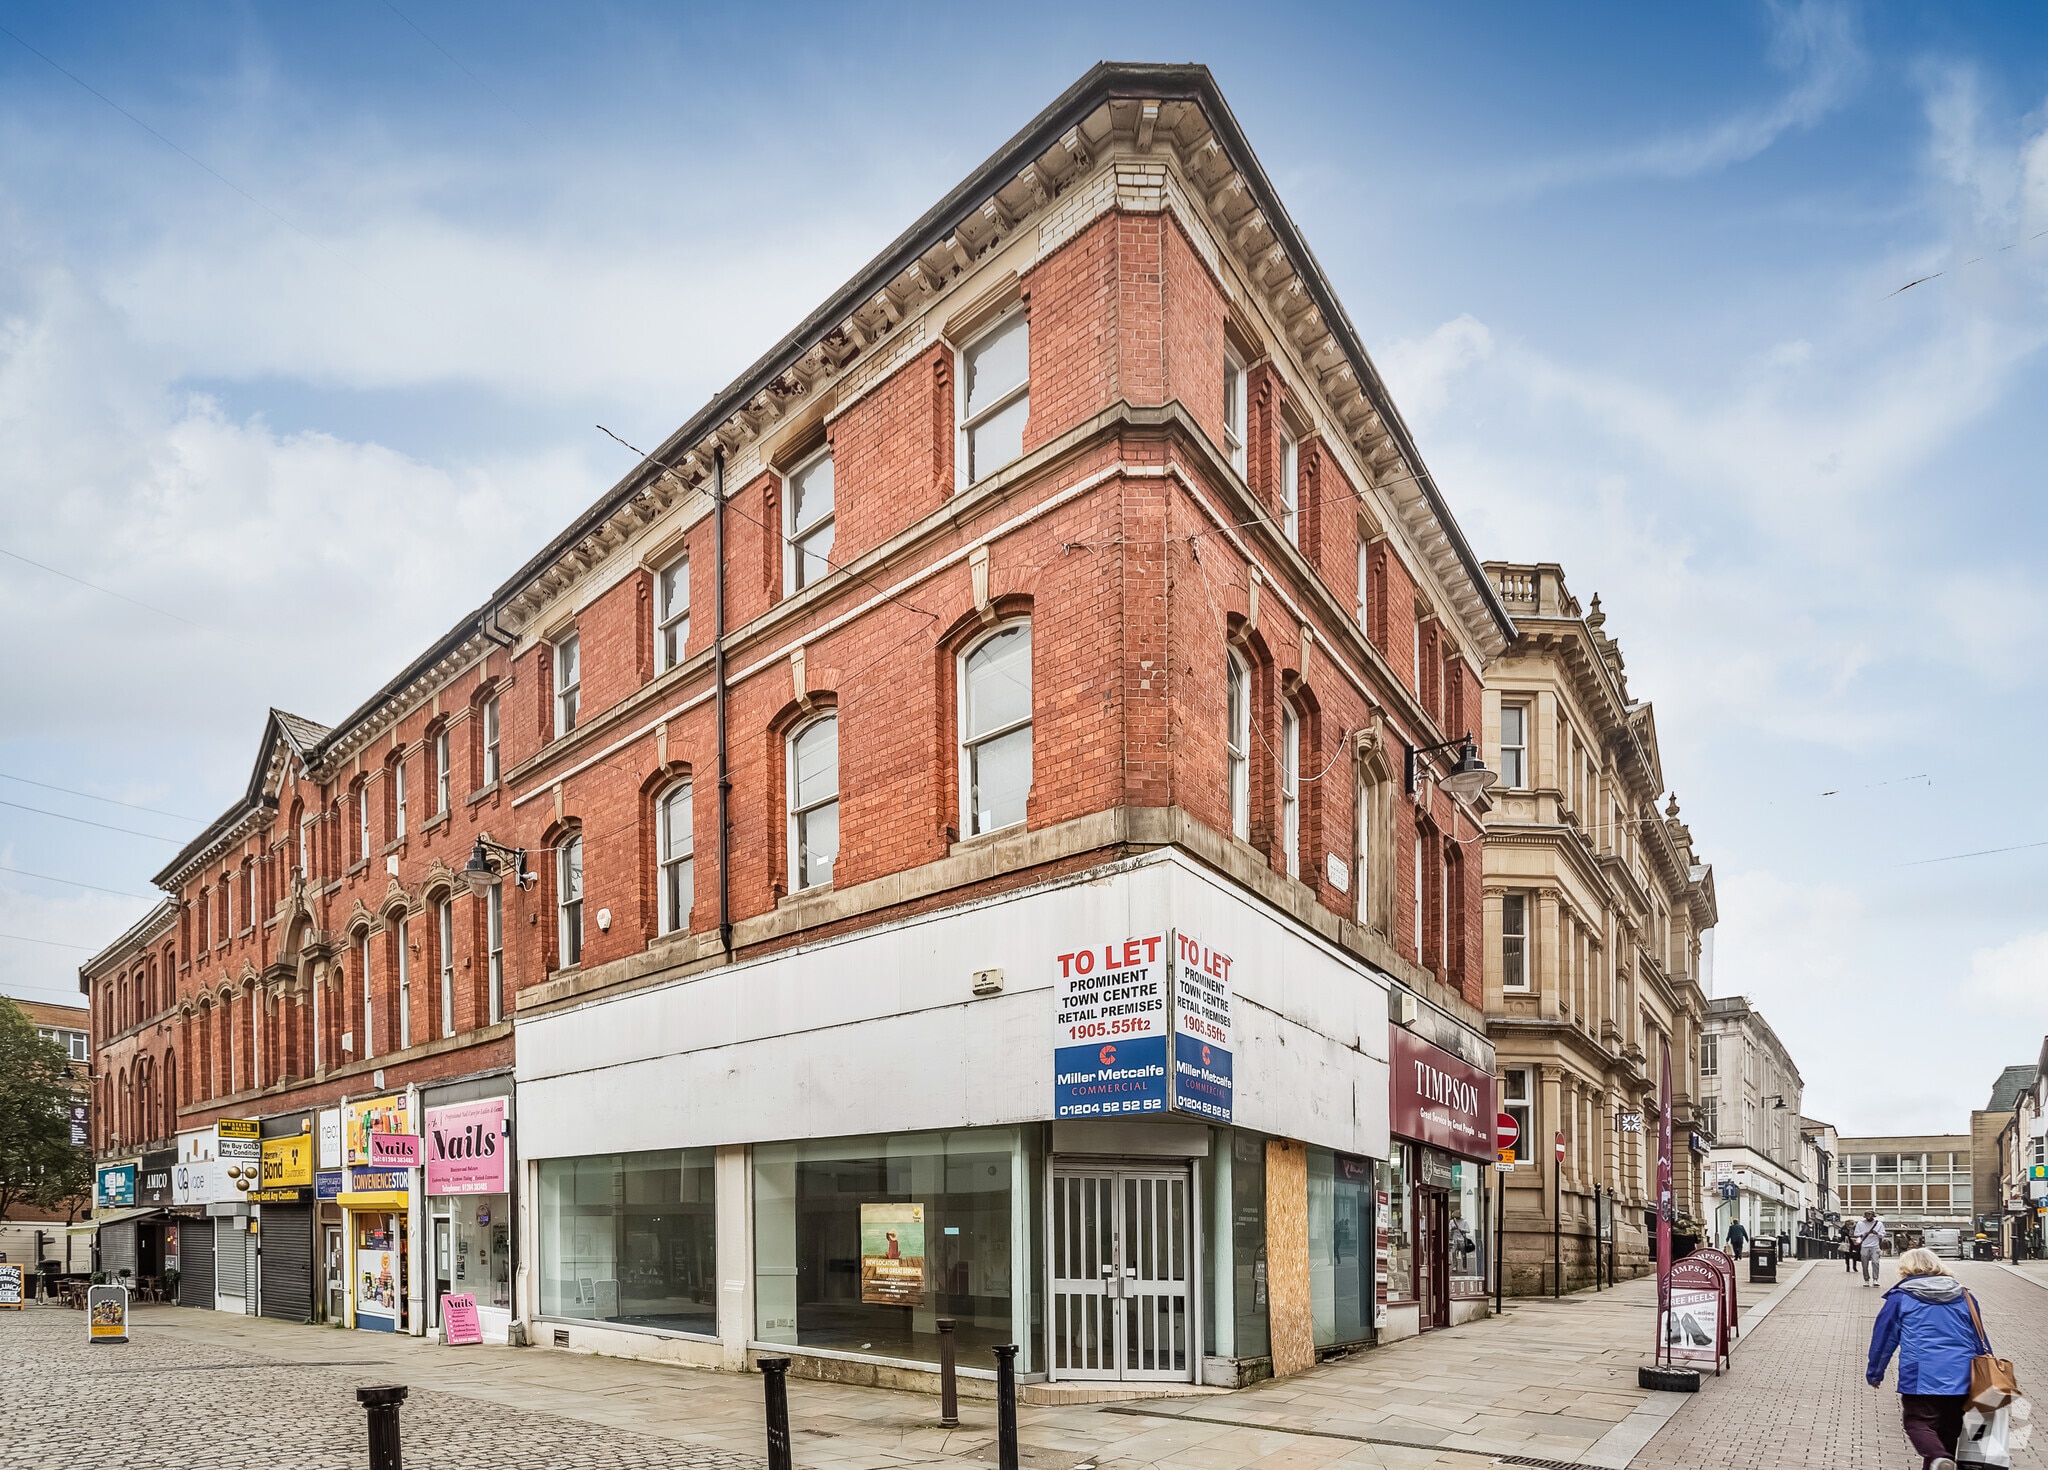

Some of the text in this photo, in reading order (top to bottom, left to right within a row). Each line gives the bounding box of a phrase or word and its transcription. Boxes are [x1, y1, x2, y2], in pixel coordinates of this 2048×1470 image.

[1058, 936, 1161, 977] TO LET
[1178, 933, 1230, 981] TO LET
[1070, 969, 1148, 992] PROMINENT
[1185, 967, 1224, 996] PROMINENT
[1062, 983, 1157, 1008] TOWN CENTRE
[1180, 980, 1228, 1012] TOWN CENTRE
[1058, 999, 1162, 1024] RETAIL PREMISES
[1178, 996, 1231, 1028] RETAIL PREMISES
[1069, 1018, 1150, 1039] 1905.55ft2
[1184, 1015, 1226, 1043] 1905.55ft2
[1058, 1065, 1164, 1085] Miller Metcalfe
[1177, 1061, 1232, 1089] Miller Metcalfe
[1072, 1082, 1148, 1096] COMMERCIAL
[1186, 1079, 1225, 1099] COMMERCIAL
[1414, 1060, 1478, 1118] TIMPSON
[1060, 1099, 1161, 1115] 01204 52 52 52
[1178, 1096, 1230, 1118] 01204 52 52 52
[1420, 1107, 1431, 1120] Great
[1432, 1112, 1446, 1126] Service
[1453, 1119, 1462, 1131] Great
[1463, 1122, 1474, 1136] People
[374, 1141, 413, 1155] Nails
[431, 1124, 496, 1162] Nails
[264, 1158, 282, 1179] Bond
[147, 1173, 167, 1188] AMICO
[354, 1172, 408, 1190] CONVENIENCE STOR
[262, 1191, 270, 1200] Gold
[279, 1191, 298, 1200] Condition
[1697, 1253, 1726, 1264] MPSON
[0, 1269, 20, 1277] OFFEE
[1671, 1265, 1714, 1279] TIMPSON
[448, 1299, 473, 1308] Nails
[1671, 1292, 1714, 1305] REE HEELS
